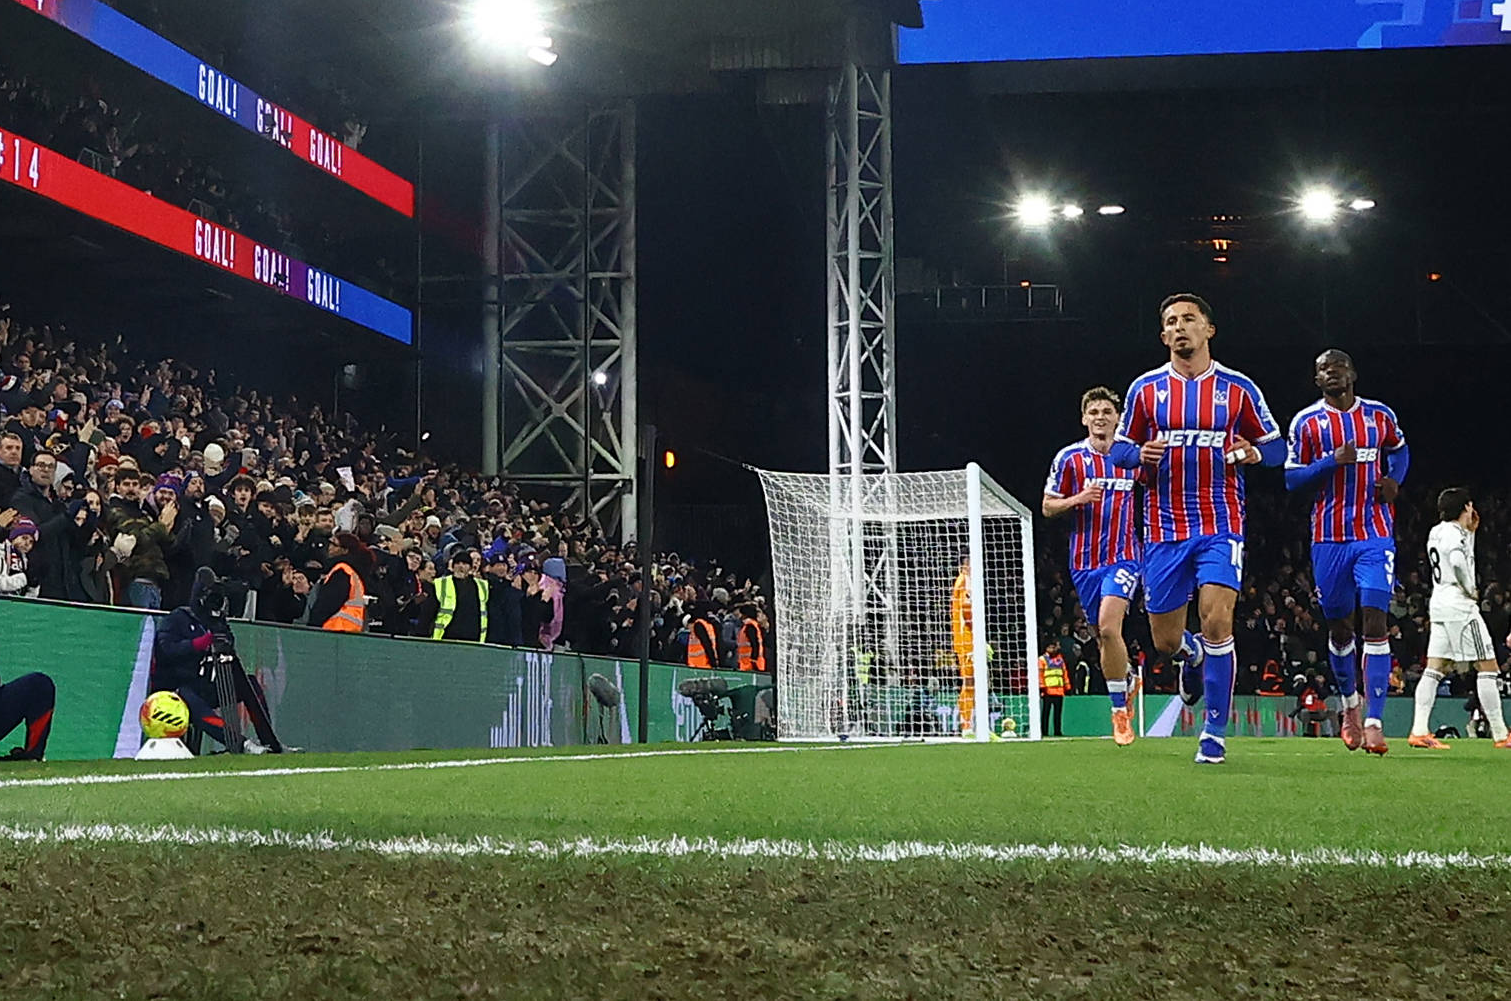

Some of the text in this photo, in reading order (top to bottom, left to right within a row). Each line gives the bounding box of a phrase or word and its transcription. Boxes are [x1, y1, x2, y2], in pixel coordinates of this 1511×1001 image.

[198, 64, 238, 118] GOAL!
[309, 129, 342, 176] GOAL!
[194, 219, 341, 312] GOAL! GOAL! GOAL!
